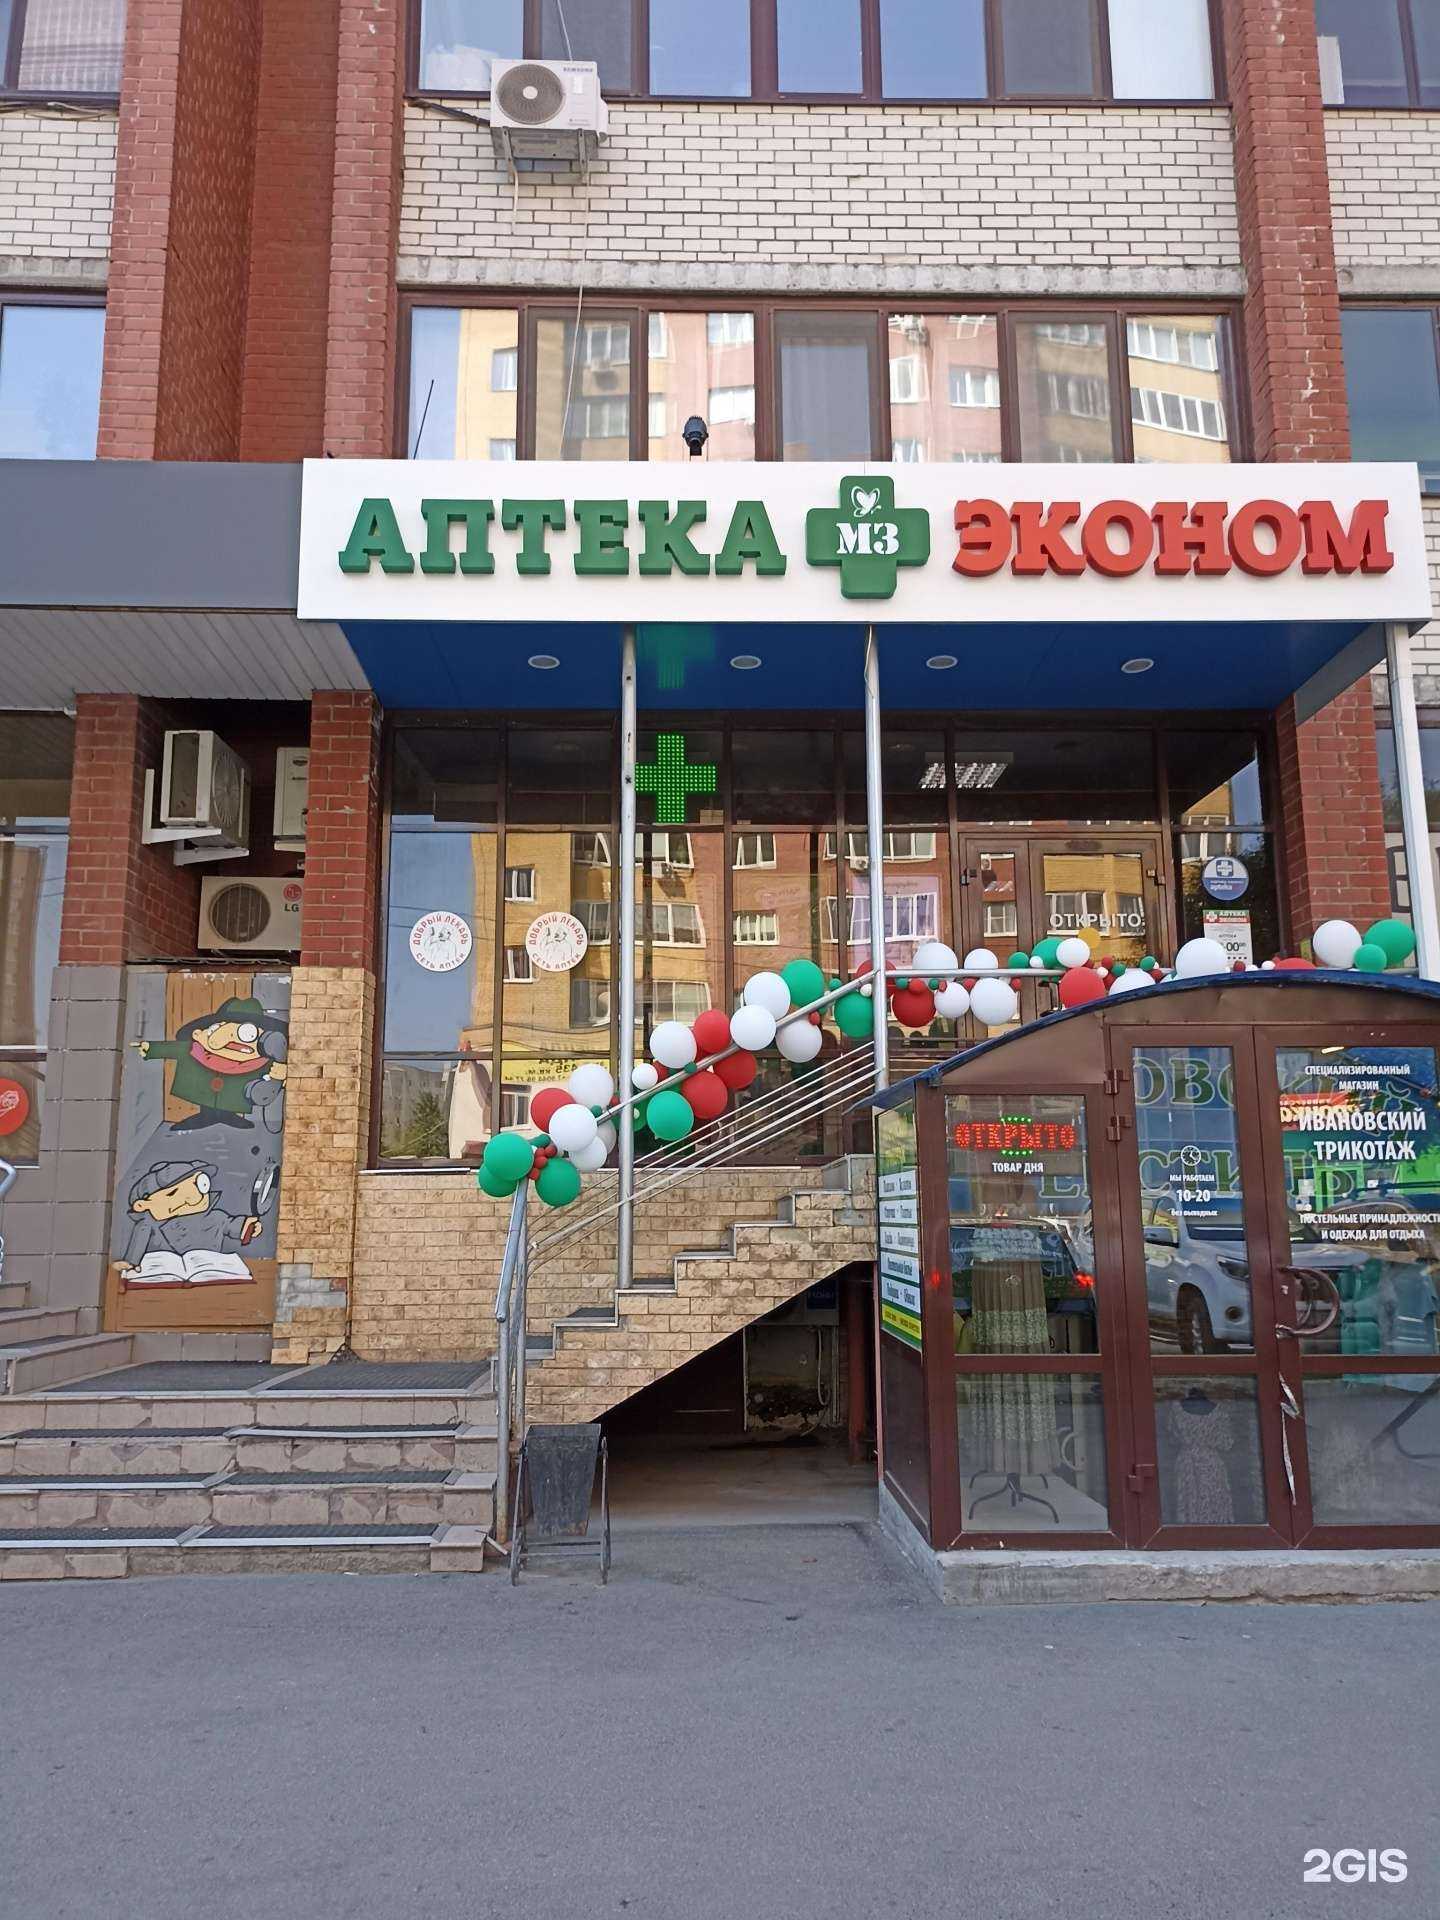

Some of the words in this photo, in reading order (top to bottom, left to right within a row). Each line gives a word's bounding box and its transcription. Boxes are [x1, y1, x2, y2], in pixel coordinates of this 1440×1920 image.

[338, 498, 787, 576] АПТЕКА
[952, 498, 1394, 578] ЭКОНОМ
[283, 903, 300, 912] LG
[1049, 913, 1142, 928] ОТКРЫТО
[1304, 1064, 1411, 1076] СПЕЦИАЛИЗИРОВАННЫЙ
[1338, 1081, 1379, 1091] МАГАЗИН
[1298, 1107, 1427, 1131] ИВАНОВСКИЙ
[954, 1122, 1077, 1150] ОТКРЫТО
[1313, 1140, 1417, 1161] ТРИКОТАЖ
[992, 1163, 1022, 1172] ТОВАР
[1023, 1163, 1044, 1174] ДНЯ
[1169, 1174, 1182, 1182] МЫ
[1182, 1174, 1215, 1182] РАБОТАЕМ
[1176, 1189, 1211, 1202] 10-20
[1299, 1213, 1358, 1224] ПОСТЕЛЬНЫЕ
[1321, 1229, 1329, 1239] И
[1329, 1229, 1368, 1240] ОДЕЖДА
[1369, 1229, 1388, 1240] ДЛЯ
[1389, 1229, 1426, 1240] ОТДЫХА
